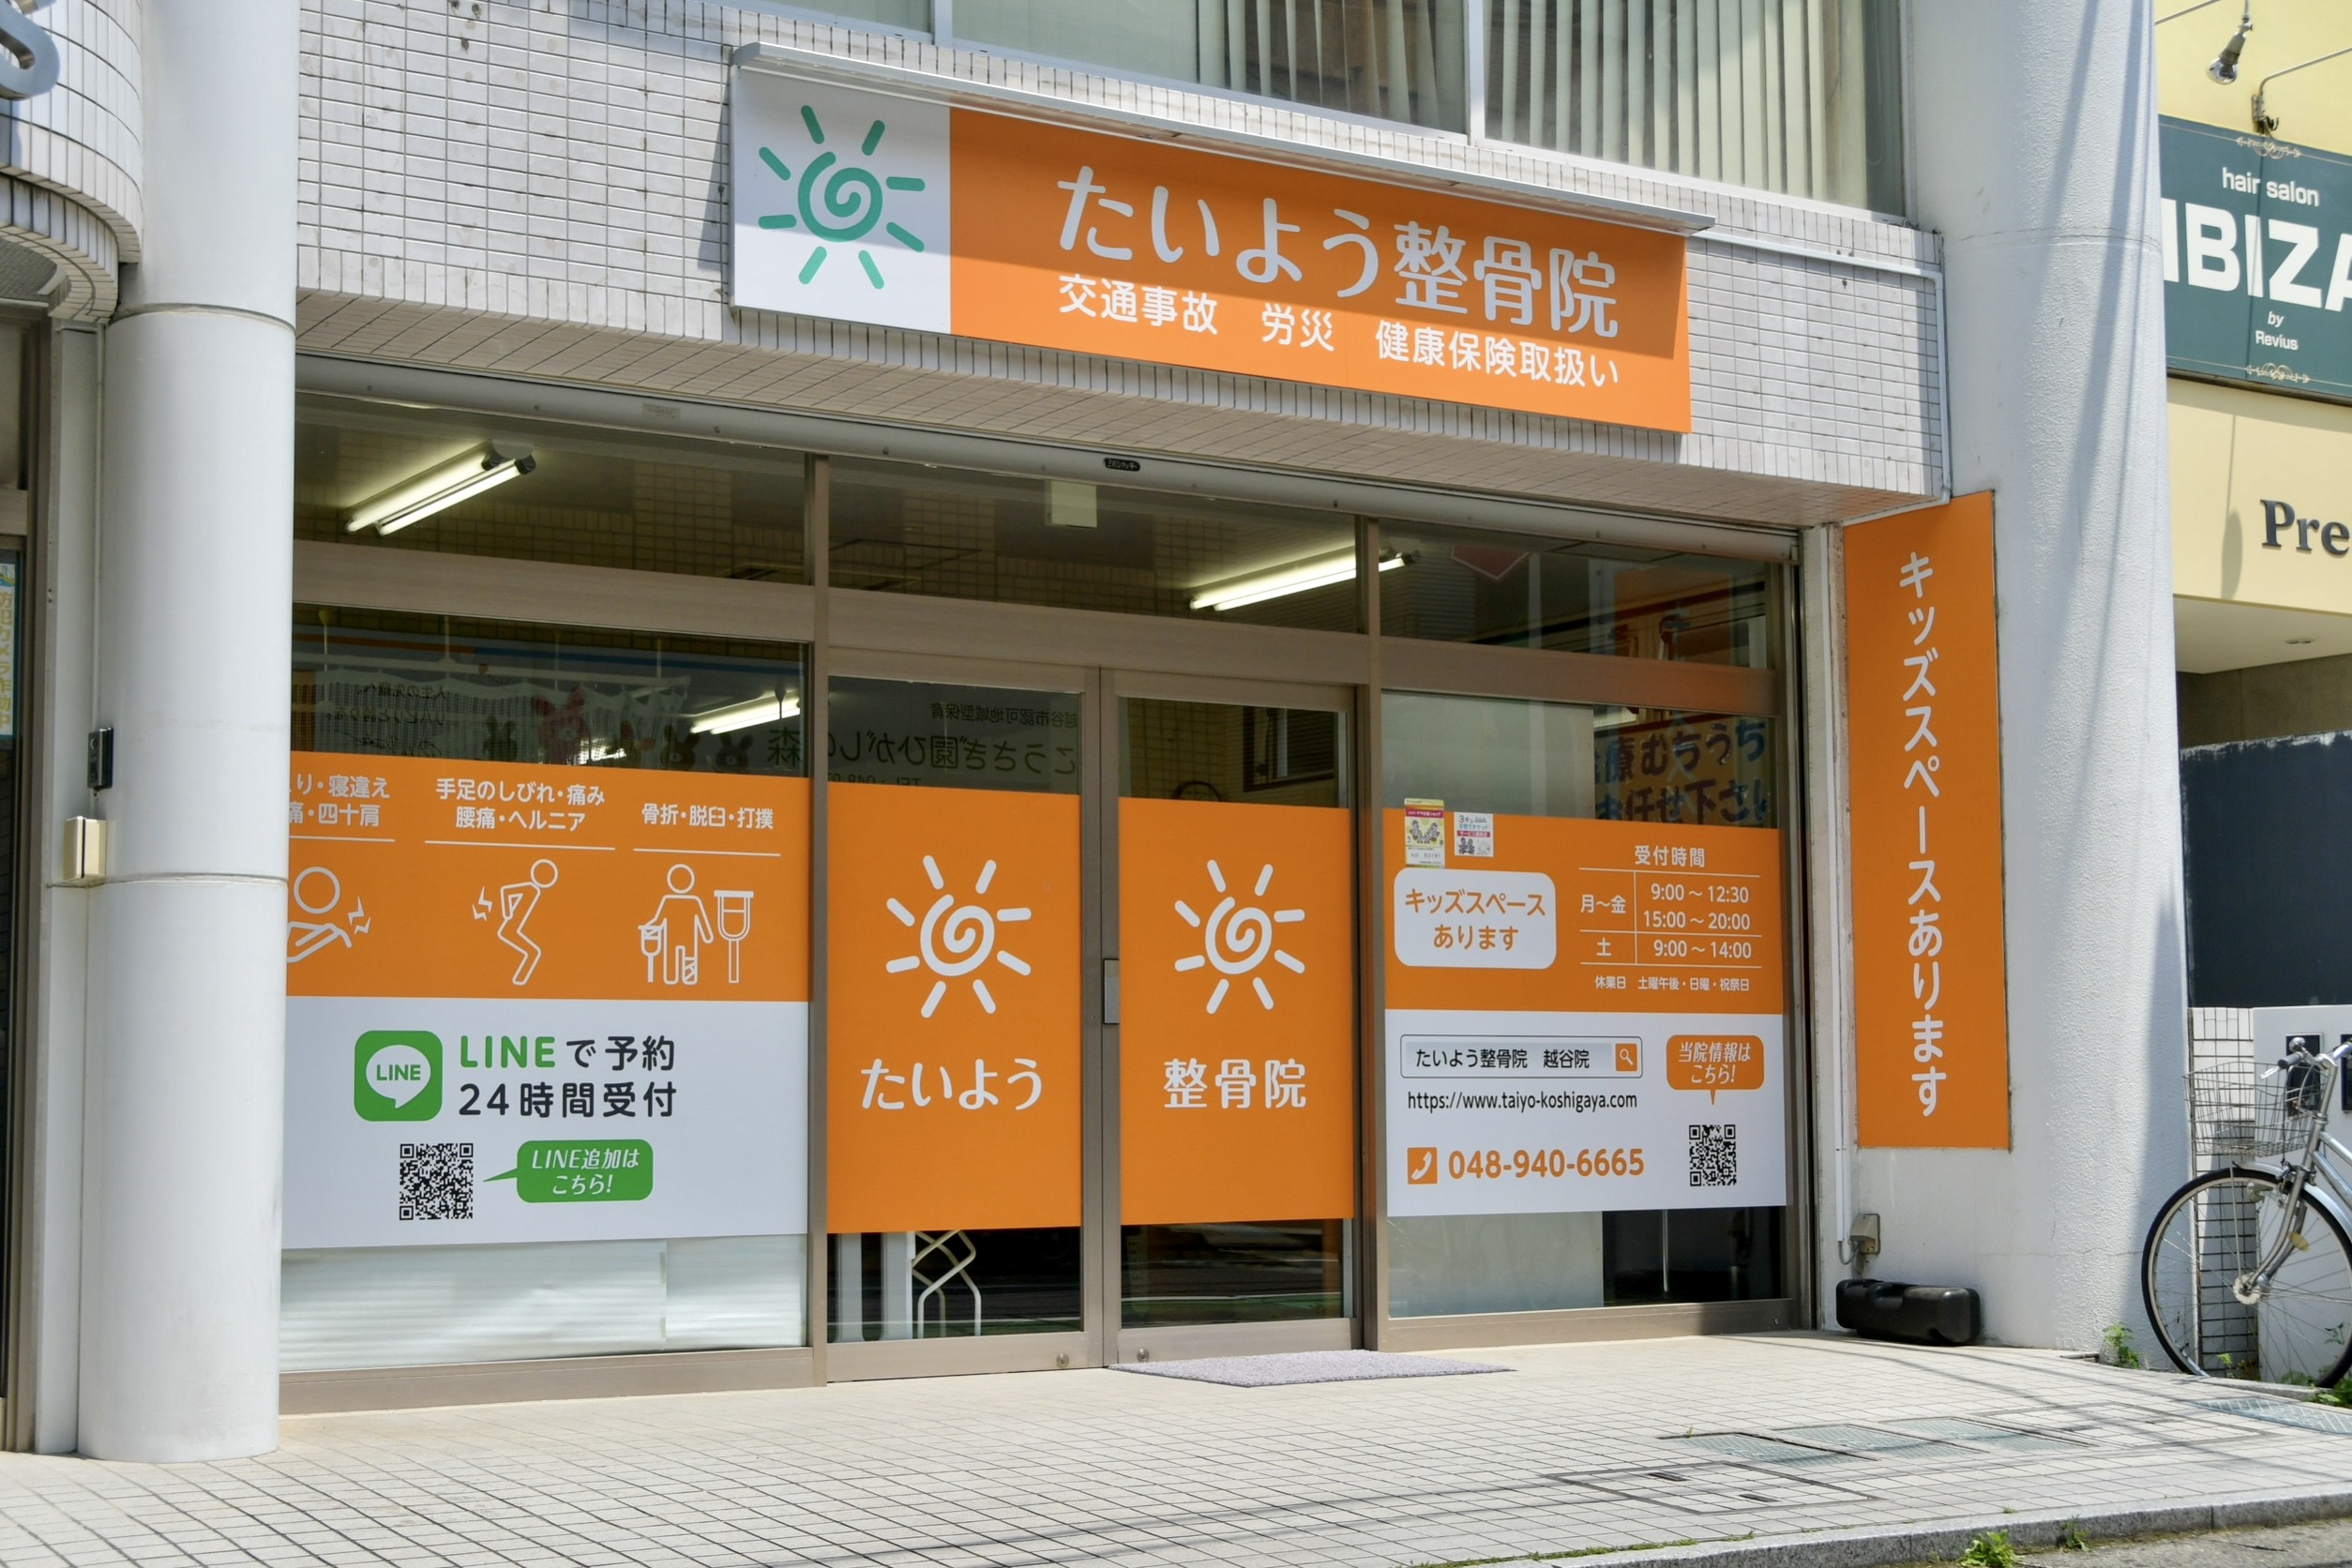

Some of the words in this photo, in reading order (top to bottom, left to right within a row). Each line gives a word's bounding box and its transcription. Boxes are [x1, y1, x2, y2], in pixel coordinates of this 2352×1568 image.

[2222, 167, 2261, 195] hair
[2265, 180, 2320, 207] salon
[1056, 165, 1620, 339] たいよう整骨院
[1058, 273, 1218, 337] 交通事故
[1260, 303, 1335, 353] 労災
[1375, 322, 1620, 388] 健康保険取扱い
[2267, 309, 2285, 328] by
[2254, 330, 2299, 352] Revius
[2259, 499, 2350, 556] Pre
[289, 774, 390, 799] り・寝違え
[435, 777, 606, 807] 手足のしびれ・痛み
[456, 806, 586, 833] 腰痛・ヘルニア
[641, 803, 775, 830] 骨折・脱臼・打撲
[1898, 550, 1947, 1118] キッズスペースあります
[1634, 844, 1706, 868] 受付時間
[1405, 887, 1546, 917] キッズスペース
[1580, 894, 1626, 915] 月～金
[1433, 923, 1519, 952] あります
[1596, 937, 1612, 957] 土
[1594, 975, 1627, 990] 休業日
[460, 1034, 677, 1072] LINEで予約
[1416, 1048, 1528, 1069] たいよう整骨院
[1543, 1049, 1591, 1069] 越谷院
[1678, 1042, 1752, 1063] 当院情報は
[376, 1063, 421, 1081] LINE
[860, 1058, 1044, 1110] たいよう
[1163, 1057, 1307, 1109] 整骨院
[1690, 1064, 1736, 1084] こちら!
[459, 1081, 678, 1118] 24時間受付
[1408, 1091, 1637, 1114] https://www.taiyo-koshigaya.com
[532, 1149, 640, 1171] LINE追加は
[1448, 1147, 1645, 1180] 048-940-6665
[553, 1175, 613, 1196] こちら!
